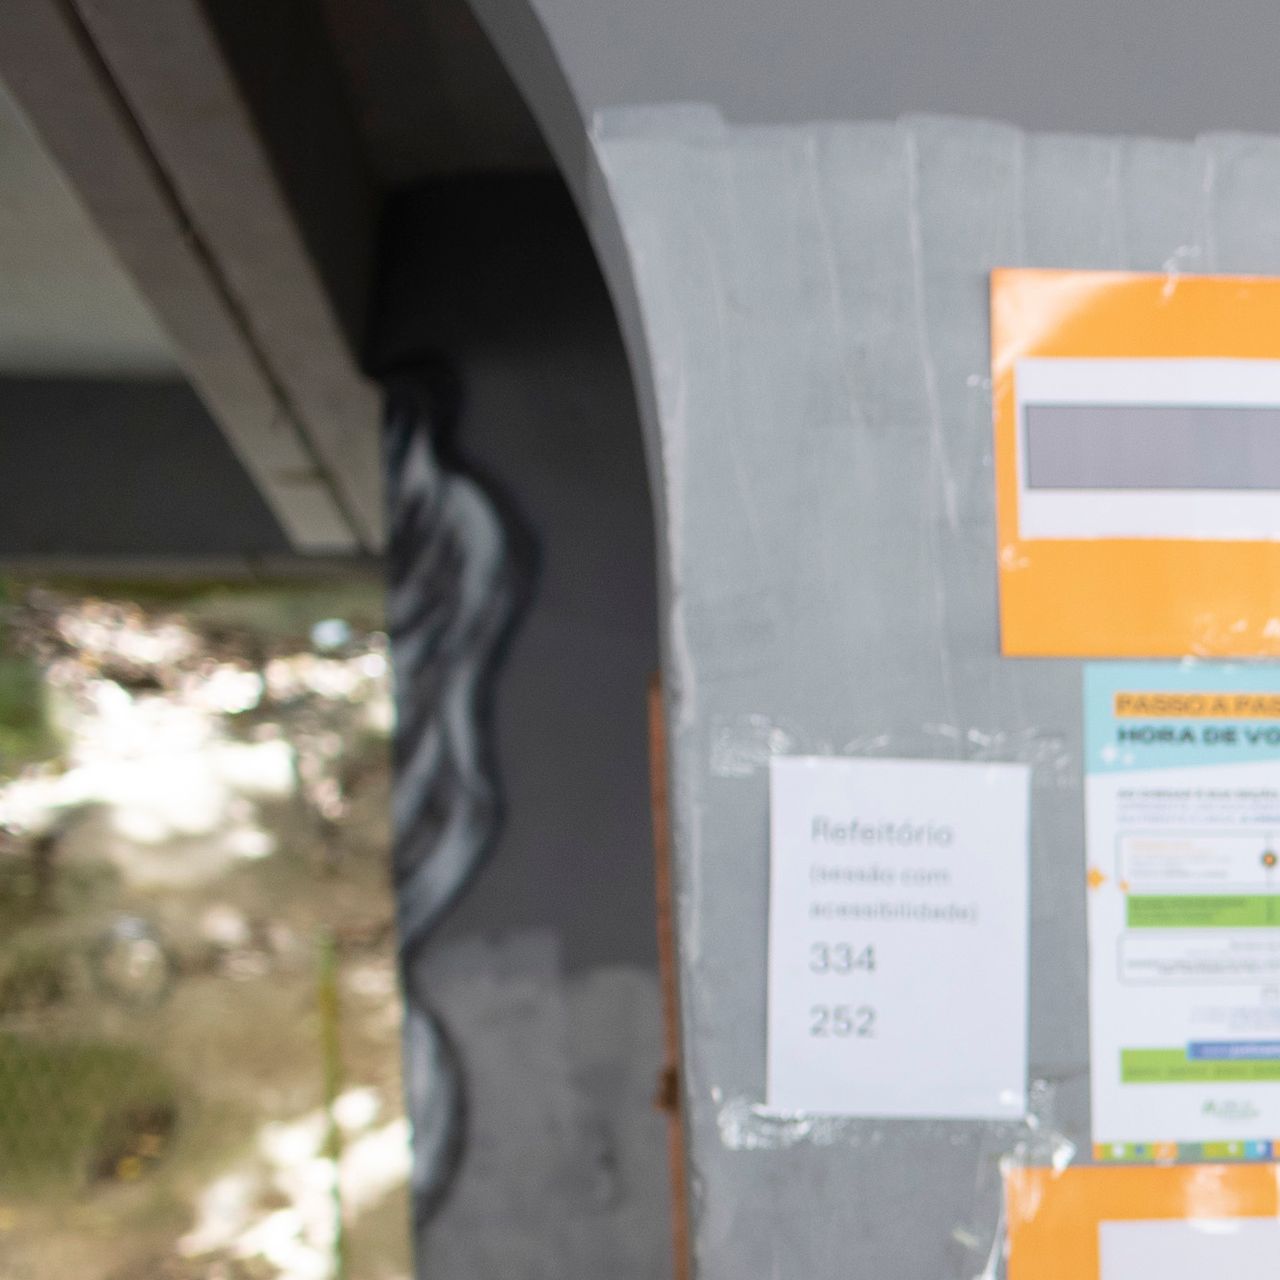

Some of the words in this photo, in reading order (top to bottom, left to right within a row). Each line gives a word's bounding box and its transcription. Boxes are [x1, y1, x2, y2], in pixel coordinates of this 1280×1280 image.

[1116, 694, 1205, 716] PASSO
[1210, 695, 1228, 715] A
[1117, 726, 1194, 745] HORA
[1202, 726, 1237, 744] DE
[811, 814, 956, 847] Refeitório
[808, 941, 878, 975] 334
[808, 1003, 878, 1039] 252
